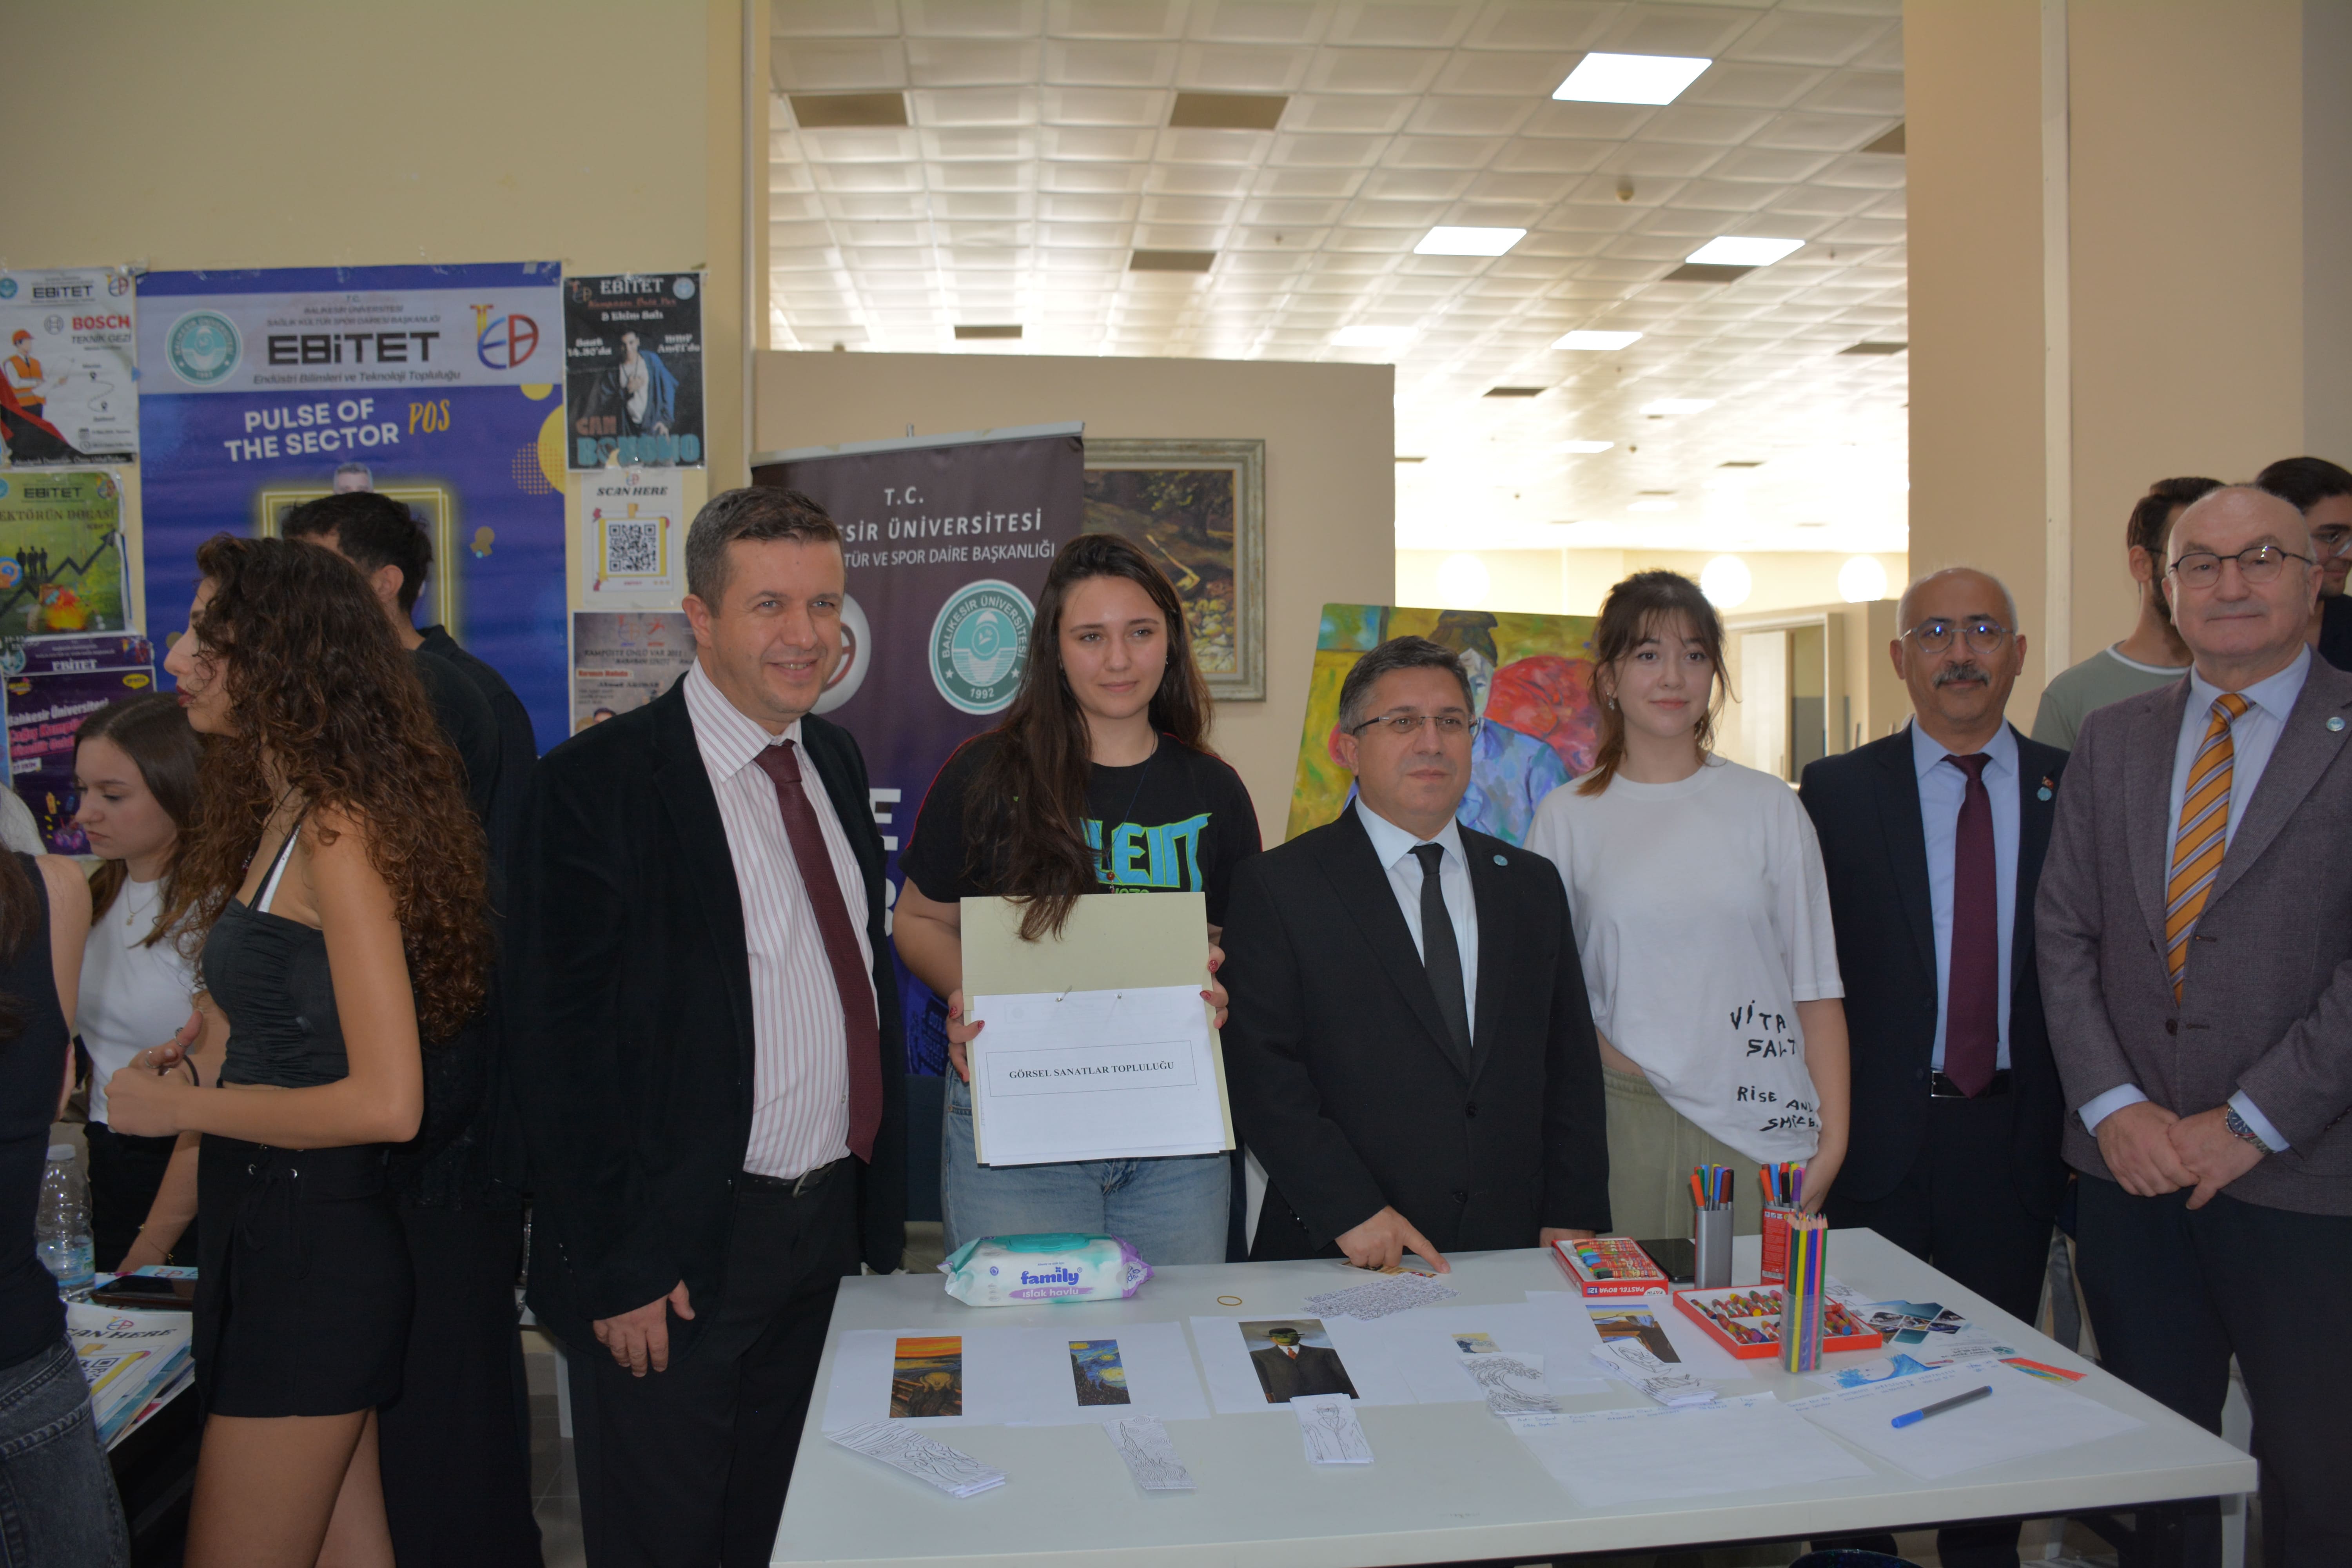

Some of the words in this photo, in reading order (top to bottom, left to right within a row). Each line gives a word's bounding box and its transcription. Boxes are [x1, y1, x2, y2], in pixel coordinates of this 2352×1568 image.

[72, 314, 131, 330] BOSCH
[253, 373, 297, 384] Endüstri
[299, 373, 343, 383] Bilimleri
[359, 371, 407, 383] Teknoloji
[413, 370, 461, 381] Topluluğu
[244, 403, 331, 433] PULSE
[337, 398, 374, 422] OF
[408, 399, 450, 435] POS
[576, 416, 617, 436] CAN
[223, 435, 281, 462] THE
[285, 422, 400, 456] SECTOR
[596, 486, 630, 496] SCAN
[632, 486, 668, 496] HERE
[884, 486, 924, 506] T.C.
[0, 508, 63, 521] EKTÖRÜN
[839, 520, 879, 543] SİR
[887, 508, 1042, 539] ÜNİVERSİTESİ
[844, 550, 869, 568] TÜR
[873, 552, 888, 566] VE
[891, 549, 925, 565] SPOR
[929, 544, 968, 563] DAİRE
[972, 539, 1055, 564] BAŞKANLIĞI
[942, 599, 978, 658] BALIKESİR
[980, 595, 1028, 658] ÜNİVERSİTESİ
[970, 688, 995, 699] 1992
[1009, 1069, 1051, 1079] GÖRSEL
[1053, 1066, 1109, 1076] SANATLAR
[1111, 1060, 1174, 1073] TOPLULUĞU
[1020, 1267, 1079, 1286] family
[1022, 1289, 1047, 1298] ıslak
[1049, 1287, 1079, 1296] havlu
[67, 1328, 107, 1337] CAN
[106, 1328, 178, 1338] HERE
